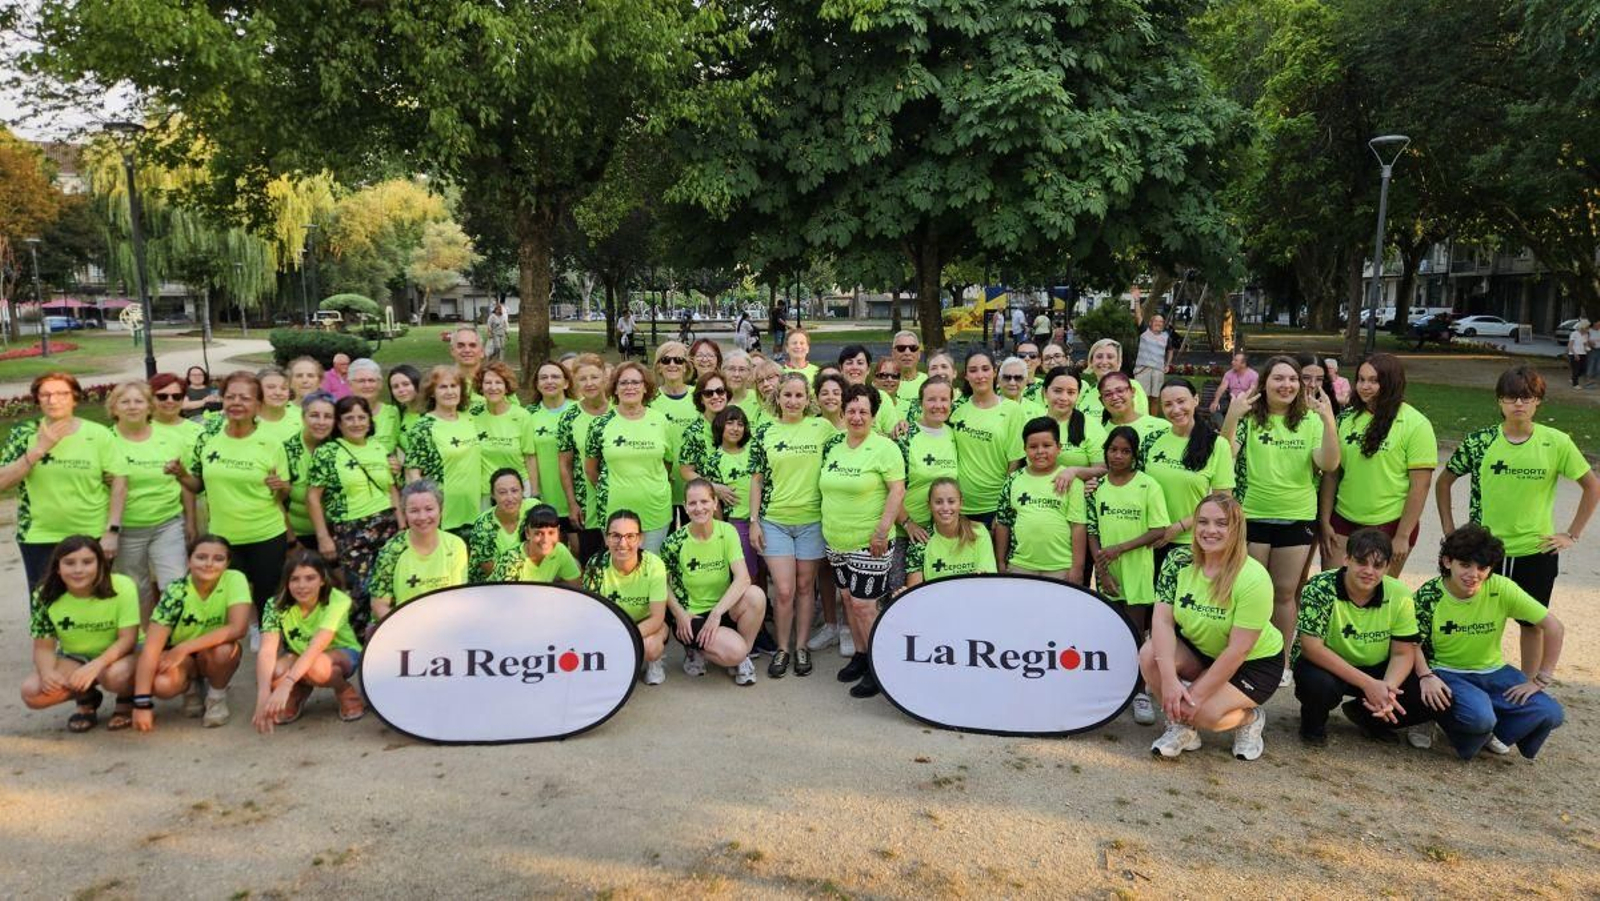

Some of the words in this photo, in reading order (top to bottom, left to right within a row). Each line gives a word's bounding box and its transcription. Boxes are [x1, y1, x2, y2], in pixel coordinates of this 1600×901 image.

[1191, 603, 1227, 615] DEPORTE
[1455, 621, 1494, 632] DEPORTE
[397, 649, 453, 678] La
[463, 645, 607, 684] Región
[902, 634, 957, 666] La
[965, 640, 1109, 679] Región
